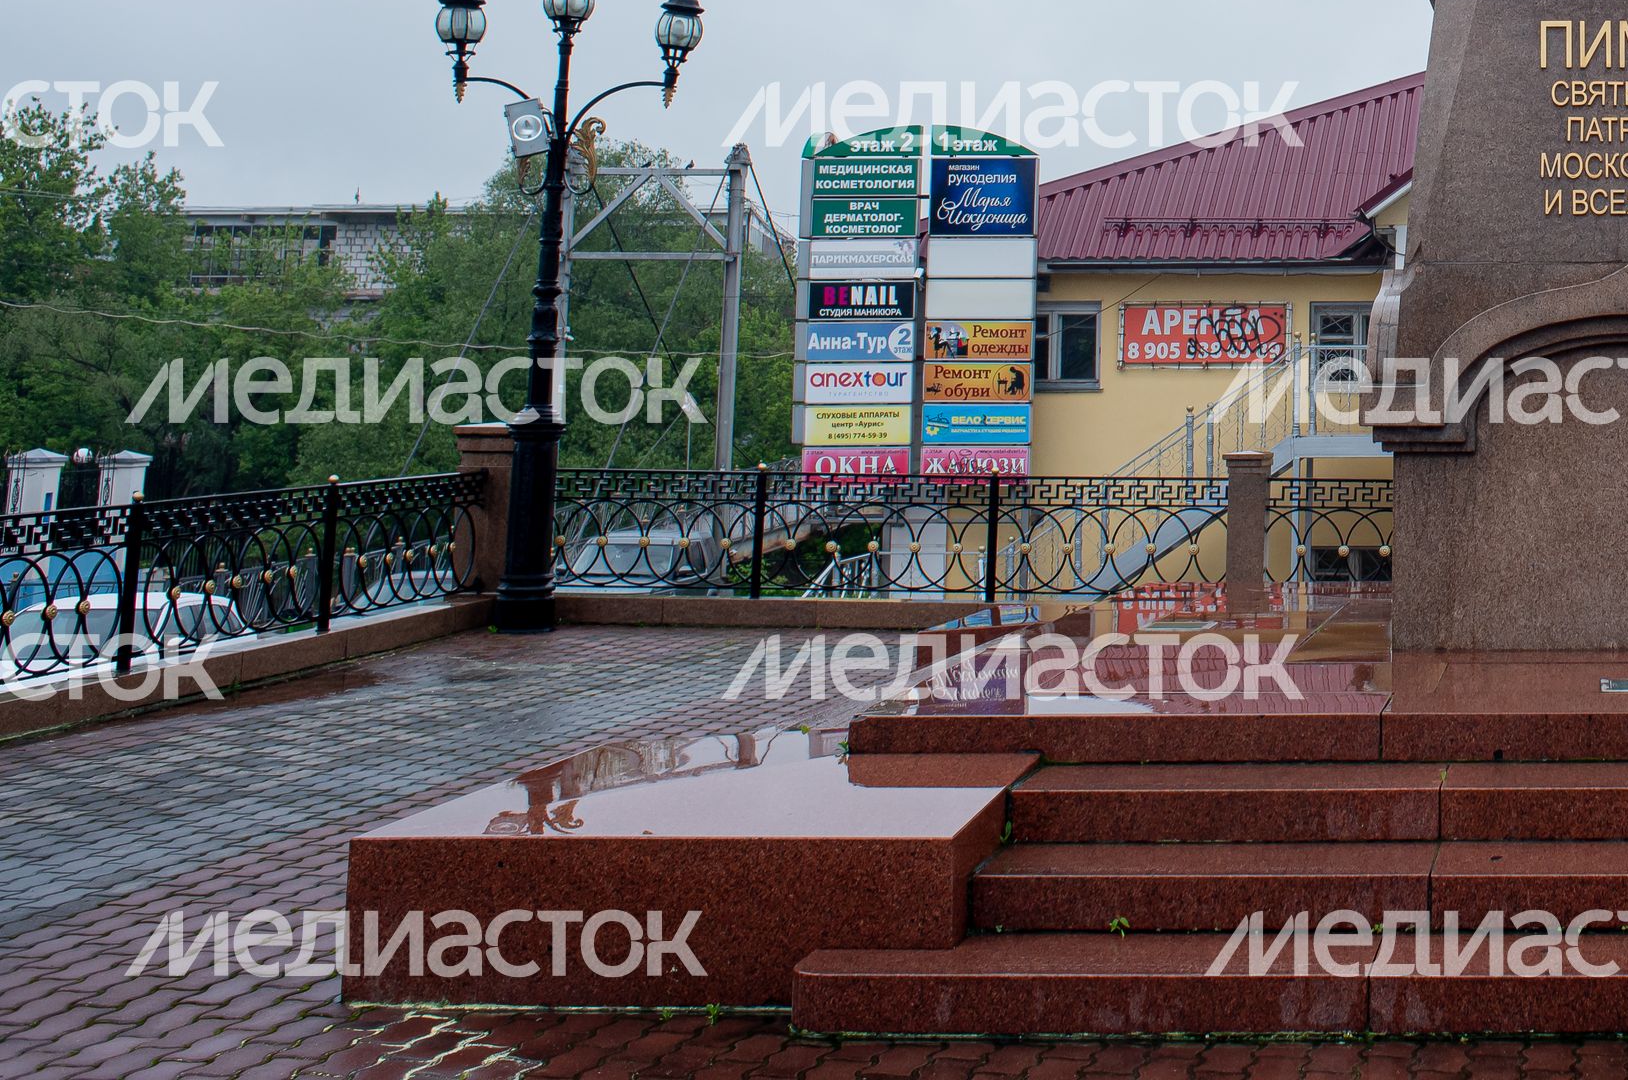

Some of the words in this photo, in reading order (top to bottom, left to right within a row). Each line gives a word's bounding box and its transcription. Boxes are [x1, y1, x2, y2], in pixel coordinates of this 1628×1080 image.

[850, 139, 895, 153] этаж
[900, 132, 914, 152] 2
[939, 131, 950, 152] 1
[952, 138, 998, 152] этаж
[819, 164, 913, 176] МЕДИЦИНСКАЯ
[815, 179, 915, 189] КОСМЕТОЛОГИЯ
[948, 173, 1017, 187] рукоделия
[850, 202, 880, 210] ВРАЧ
[942, 187, 1012, 213] Марья
[1544, 189, 1562, 215] И
[824, 213, 905, 224] ДЕРМАТОЛОГ-
[937, 204, 1029, 232] Искусница
[825, 224, 902, 234] КОСМЕТОЛОГ
[811, 254, 915, 264] ПАРИКМАХЕРСКАЯ
[819, 308, 853, 317] СТУДИЯ
[854, 308, 902, 317] МАНИКЮРА
[1141, 308, 1264, 340] АРЕНДА
[898, 328, 912, 346] 2
[972, 325, 1027, 338] Ремонт
[808, 332, 887, 354] Анна-Тур
[971, 343, 1029, 356] одежды
[1127, 342, 1140, 359] 8
[1144, 342, 1181, 360] 905
[934, 366, 991, 380] Ремонт
[944, 384, 991, 400] обуви
[816, 411, 857, 420] СЛУХОВЫЕ
[858, 410, 900, 419] АППАРАТЫ
[951, 415, 981, 425] ВЕЛО
[831, 421, 853, 429] центр
[827, 432, 832, 440] 8
[833, 432, 852, 440] (495)
[815, 455, 898, 479] ОКНА
[925, 457, 1026, 474] ЖАЛЮЗИ
